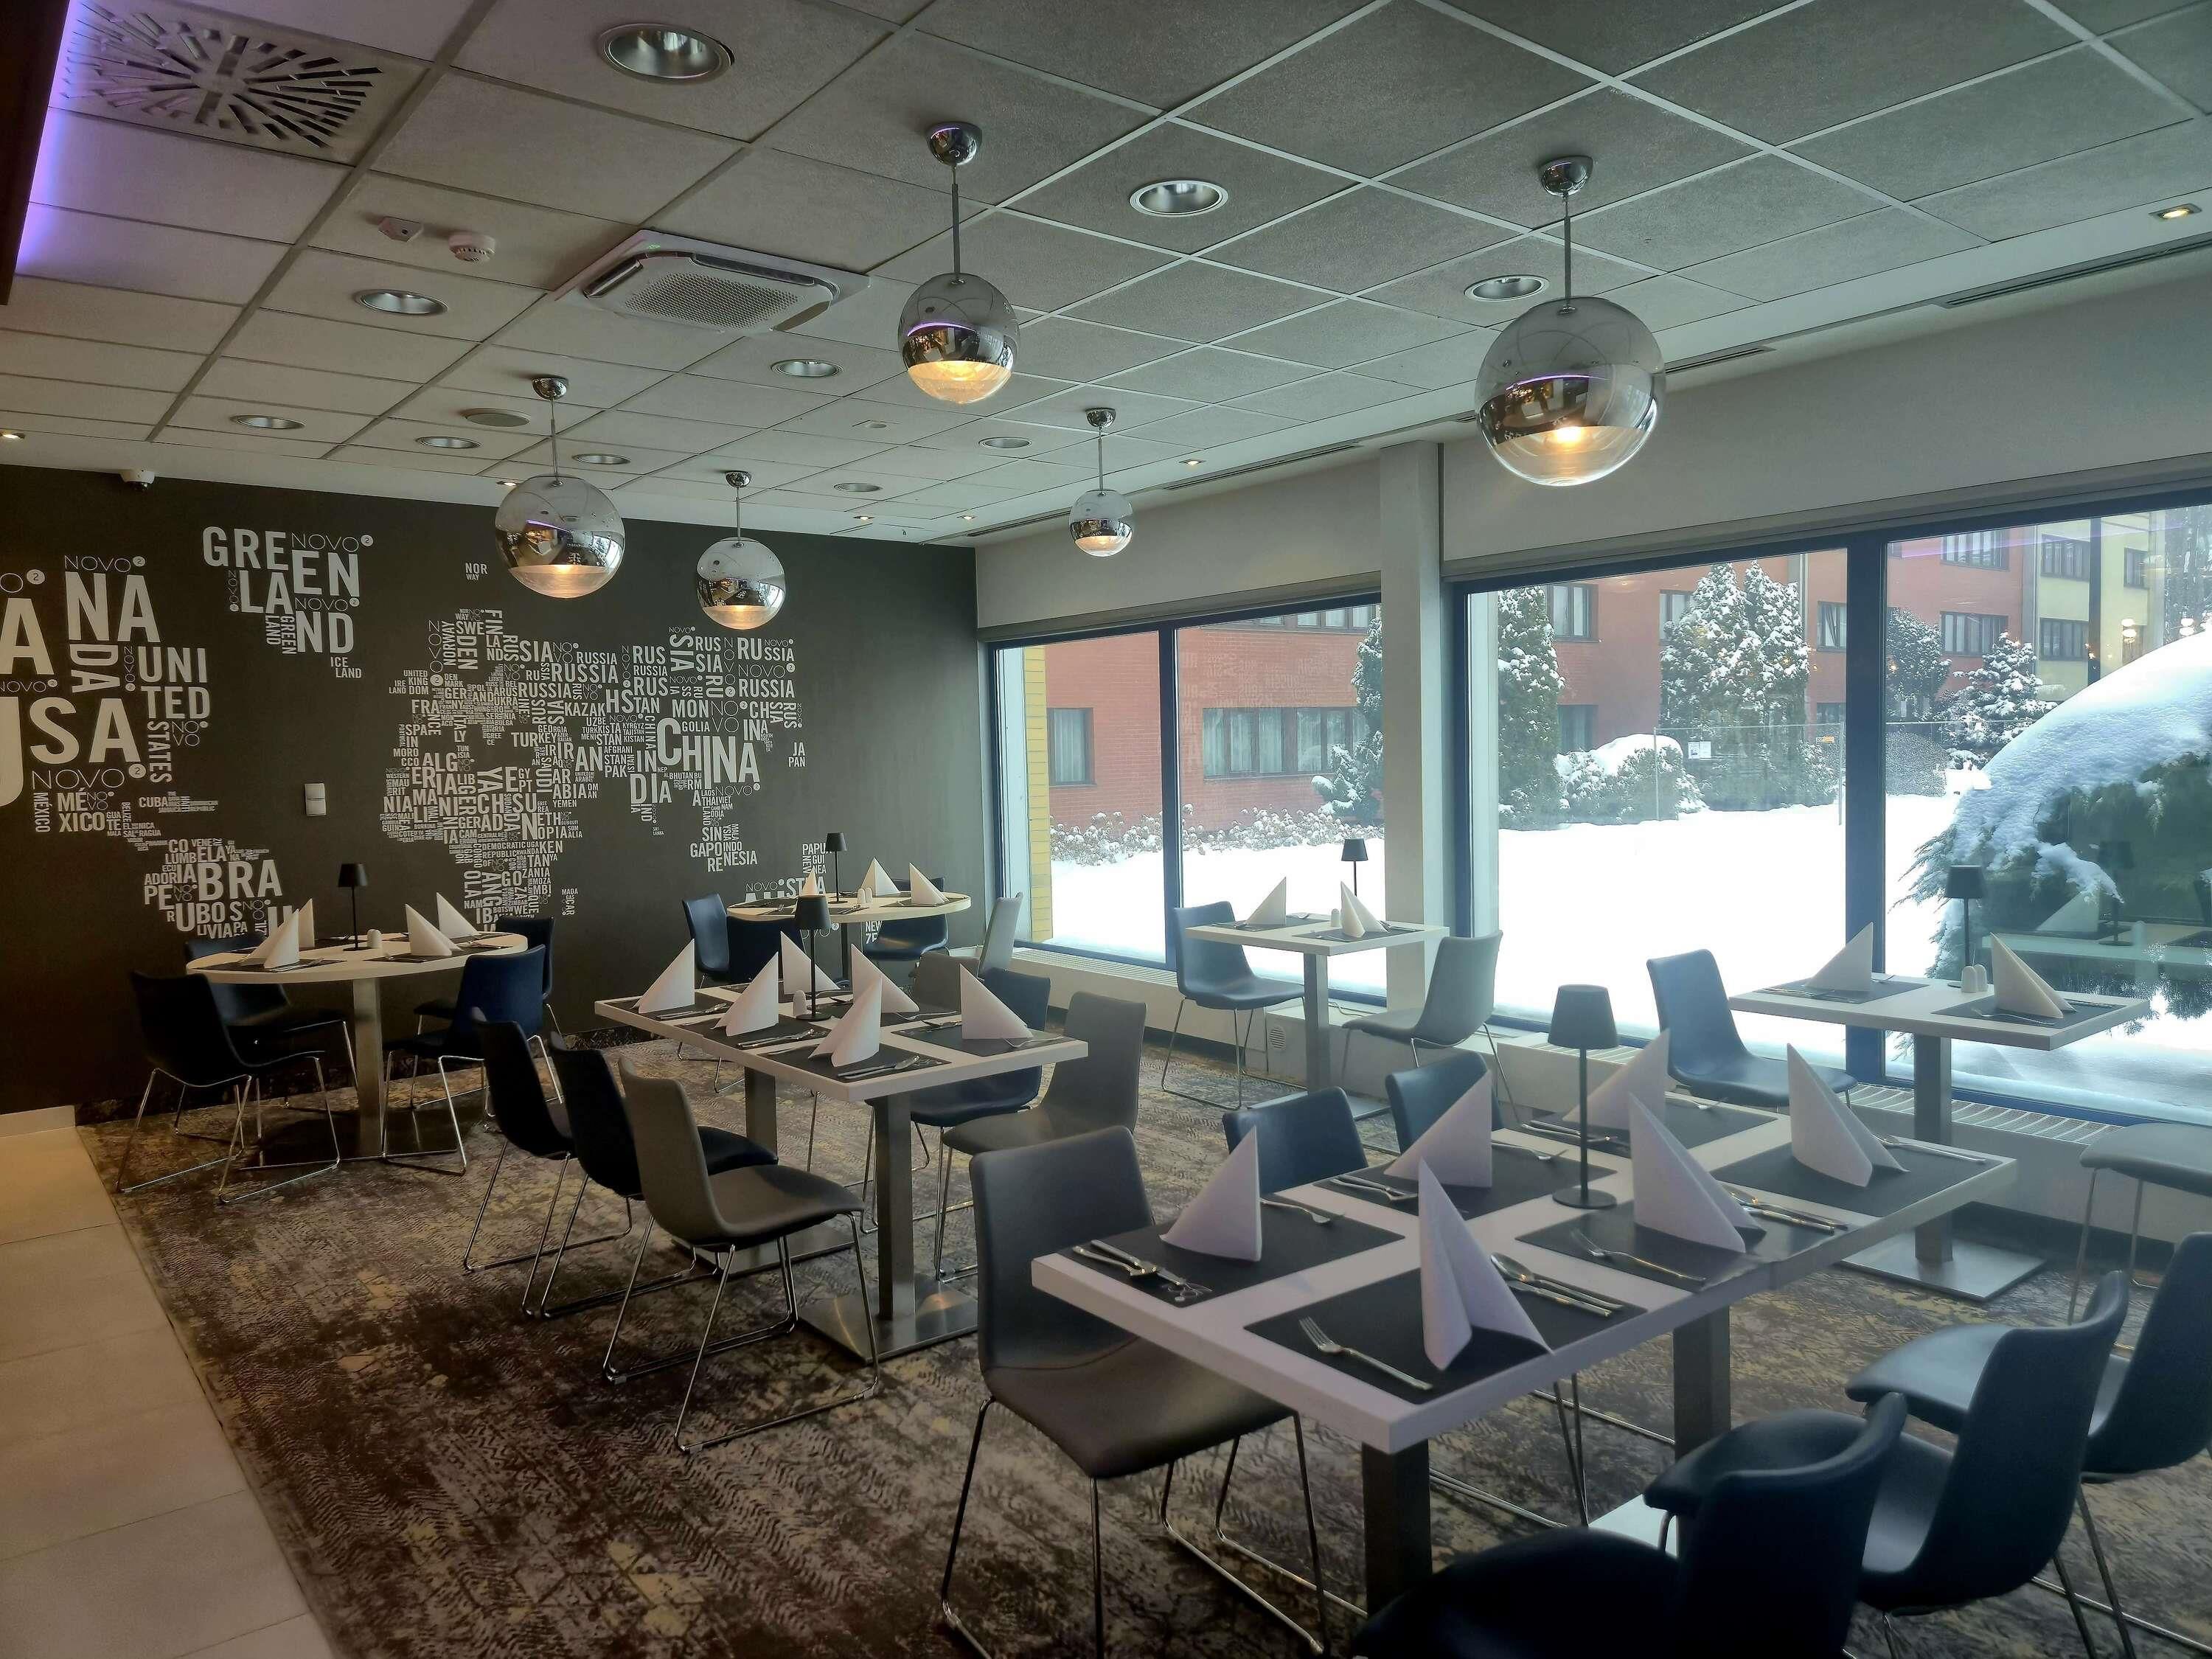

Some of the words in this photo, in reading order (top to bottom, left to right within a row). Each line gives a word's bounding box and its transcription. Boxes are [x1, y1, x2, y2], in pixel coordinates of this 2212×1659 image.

[465, 563, 488, 574] NOR
[456, 621, 485, 635] SWE
[485, 609, 503, 634] FIN
[265, 615, 281, 645] LAND
[279, 615, 296, 655] GREEN
[442, 621, 456, 666] NORWAY
[520, 640, 553, 663] SIA
[695, 636, 722, 652] RUS
[457, 636, 478, 670] DEN
[577, 651, 617, 665] RUSSIA
[633, 646, 666, 664] RUS
[669, 634, 695, 672] SIA
[138, 647, 207, 684] UNI
[330, 657, 348, 667] ICE
[696, 654, 723, 672] SIA
[335, 668, 362, 678] LAND
[552, 663, 619, 684] RUSSIA
[633, 665, 668, 676] RUSSIA
[408, 677, 428, 686] KING
[634, 677, 669, 696] RUS
[706, 675, 724, 698] RU
[739, 678, 796, 698] RUSSIA
[389, 686, 406, 695] LAND
[408, 686, 429, 695] DOM
[518, 683, 571, 698] RUSSIA
[141, 686, 210, 719] TED
[411, 699, 439, 714] FRA
[672, 699, 709, 718] MON
[749, 701, 770, 719] CH
[538, 725, 568, 734] GEORGIA
[645, 715, 656, 750] CHINA
[682, 721, 710, 732] GOLIA
[743, 720, 768, 741] INA
[511, 731, 557, 748] TURKEY
[147, 720, 173, 783] STATES
[393, 748, 419, 757] MORO
[604, 745, 633, 754] AFGHANI
[657, 717, 761, 790] CHINA
[793, 742, 806, 757] JA
[401, 757, 420, 766] CCO
[422, 752, 458, 772] ALG
[605, 754, 627, 765] STAN
[788, 757, 806, 768] PAN
[536, 757, 553, 793] SAUDI
[605, 765, 627, 778] PAK
[552, 783, 588, 799] ABIA
[630, 773, 672, 804] DIA
[139, 796, 168, 808] CUBA
[383, 796, 414, 813] NIA
[504, 793, 512, 814] SUDAN
[552, 799, 577, 808] YEMEN
[701, 796, 719, 807] THAI
[59, 812, 105, 832] XICO
[703, 806, 711, 826] LAND
[702, 827, 723, 842] SIN
[168, 839, 189, 853] CO
[482, 841, 526, 850] DEMOCRATIC
[539, 841, 563, 854] KEN
[690, 842, 723, 858] GAPO
[723, 841, 742, 852] INDO
[473, 844, 483, 868] CONGO
[482, 849, 517, 859] REPUBLIC
[527, 854, 550, 867] TAN
[723, 850, 758, 866] NESIA
[813, 855, 824, 864] GUI
[707, 857, 723, 872] RE
[144, 872, 177, 886] ADOR
[198, 860, 283, 901] BRA
[522, 868, 550, 878] ZANIA
